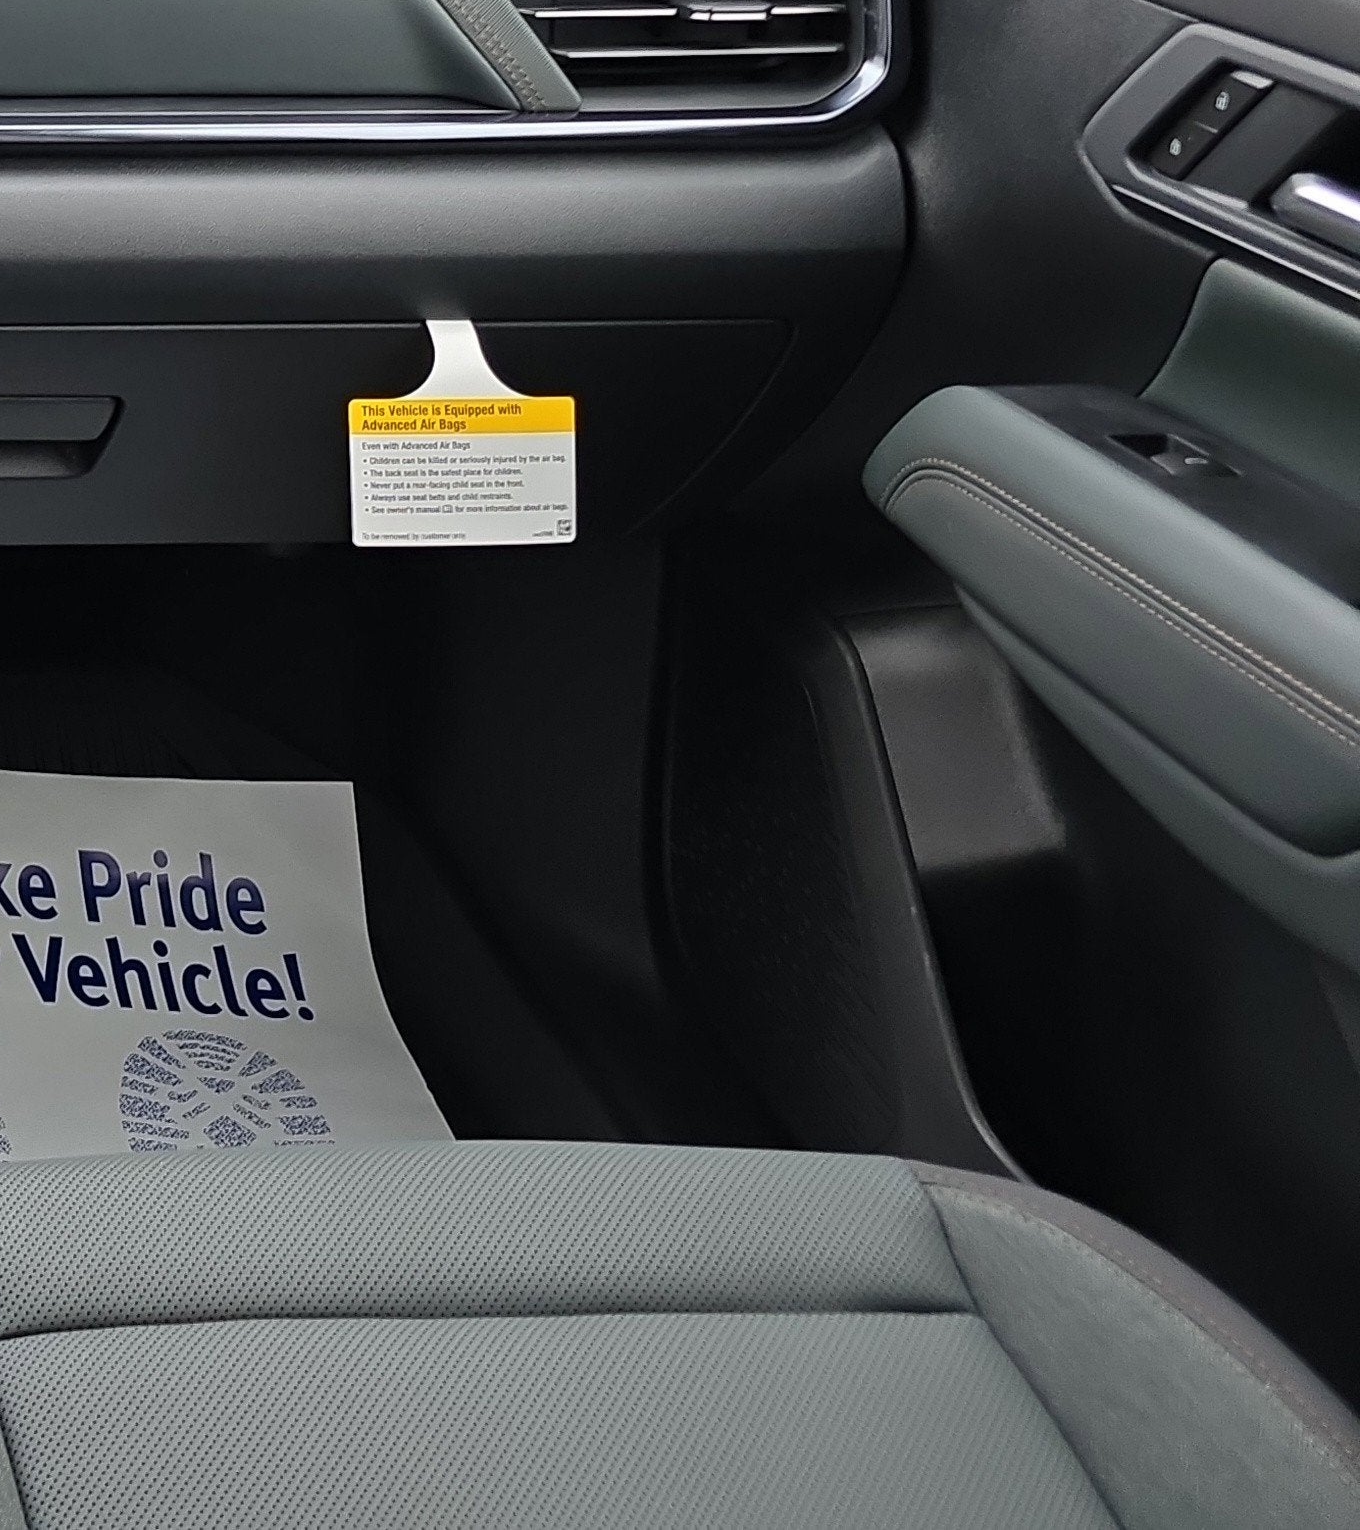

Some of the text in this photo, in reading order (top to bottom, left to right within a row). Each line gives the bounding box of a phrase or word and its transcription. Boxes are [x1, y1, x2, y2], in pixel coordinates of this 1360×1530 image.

[362, 403, 522, 417] This Vehicle is Equipped with
[361, 419, 467, 433] Advanced Air Bags
[362, 442, 380, 450] Even
[383, 442, 399, 450] with
[401, 442, 438, 450] Advanced
[452, 441, 470, 451] Bags
[370, 457, 400, 465] Children
[428, 456, 448, 464] killed
[459, 456, 491, 465] seriously
[493, 456, 517, 464] injured
[519, 456, 527, 464] by
[78, 849, 267, 935] Pride
[12, 933, 315, 1022] Vehicle!
